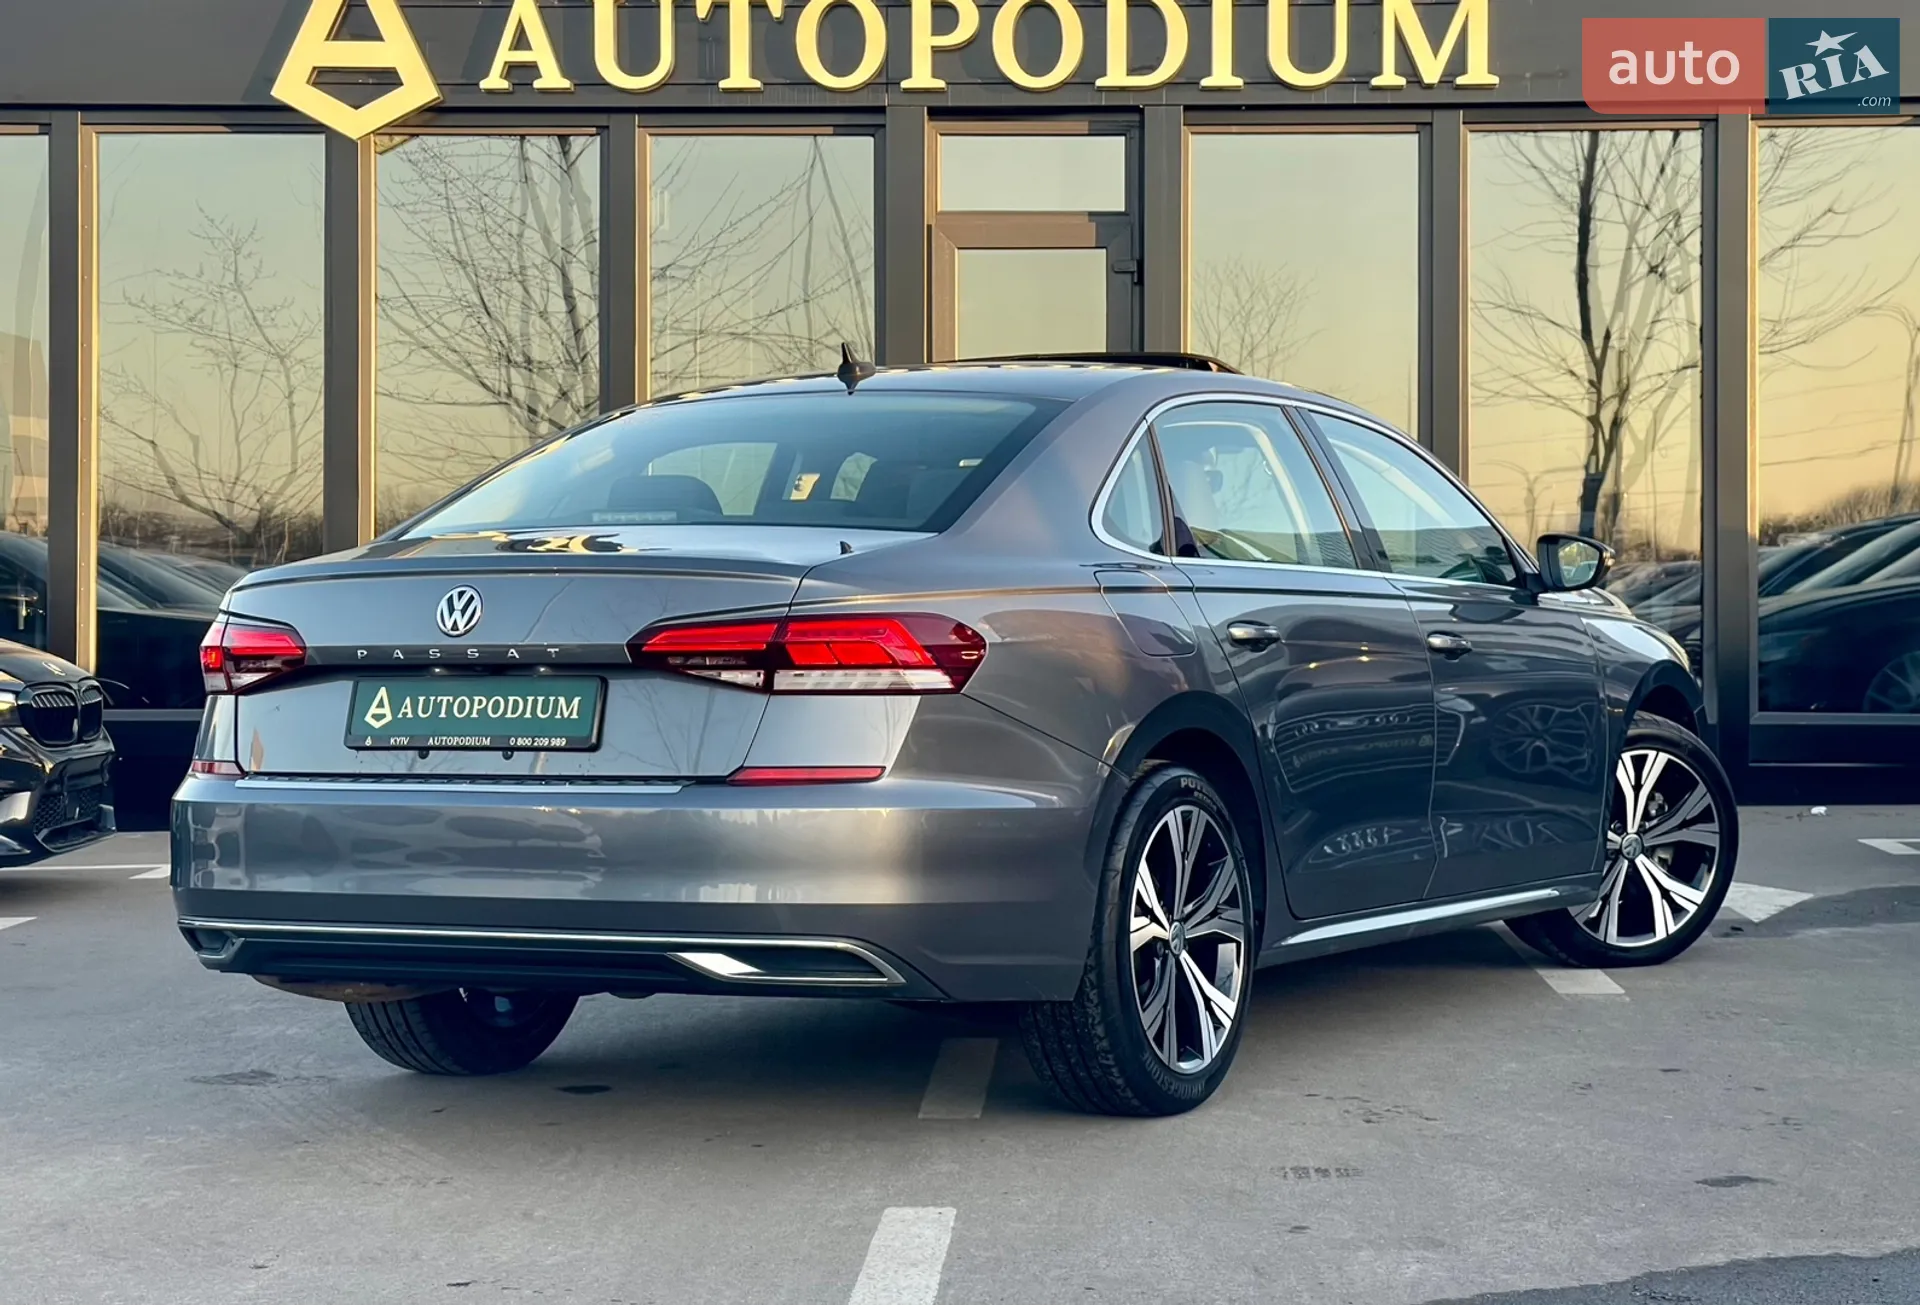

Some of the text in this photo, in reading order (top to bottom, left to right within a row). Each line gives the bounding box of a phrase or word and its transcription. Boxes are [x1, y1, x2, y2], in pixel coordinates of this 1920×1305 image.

[478, 0, 1500, 92] AUTOPODIUM
[357, 647, 560, 660] PASSAT
[397, 695, 582, 719] AUTOPODIUM
[390, 736, 567, 747] KYIV AUTOPODIUM 0 800 209 989
